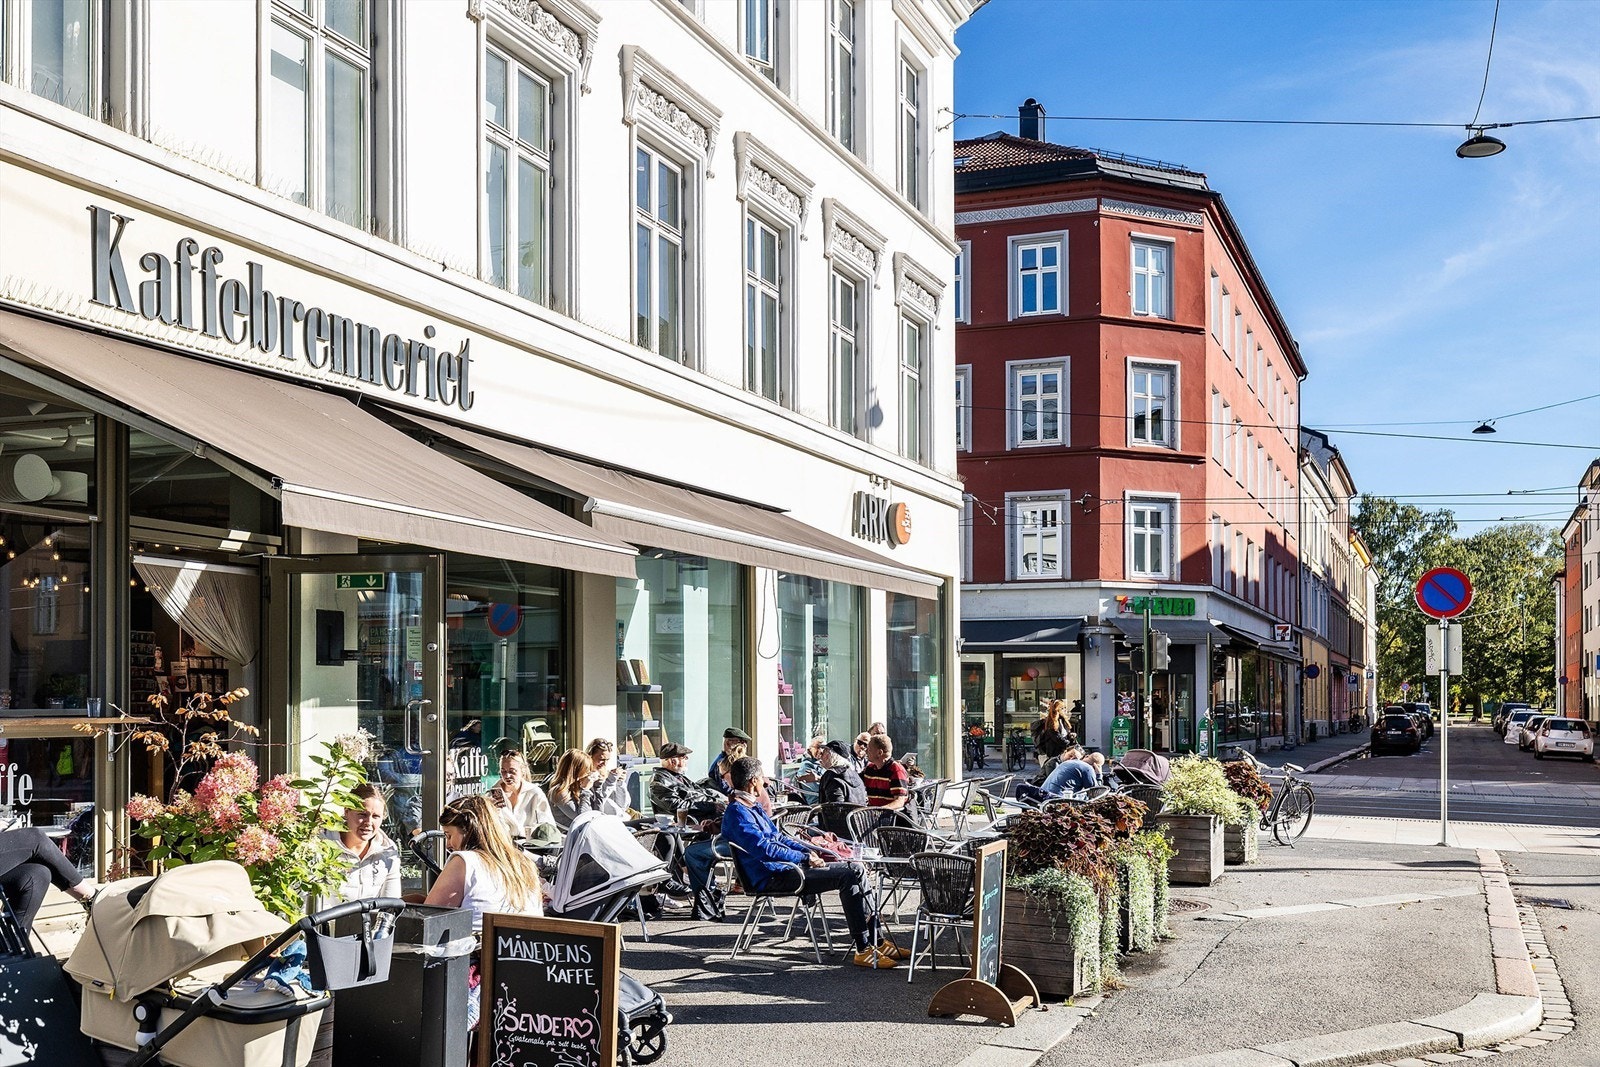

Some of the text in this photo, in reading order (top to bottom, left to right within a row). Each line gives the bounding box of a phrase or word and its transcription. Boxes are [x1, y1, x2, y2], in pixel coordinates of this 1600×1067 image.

[86, 204, 476, 412] Kaffebrenneriet
[855, 490, 889, 542] ARK
[449, 746, 489, 779] Kaffe
[497, 934, 592, 964] MÅNEDENS
[546, 964, 596, 986] KAFFE
